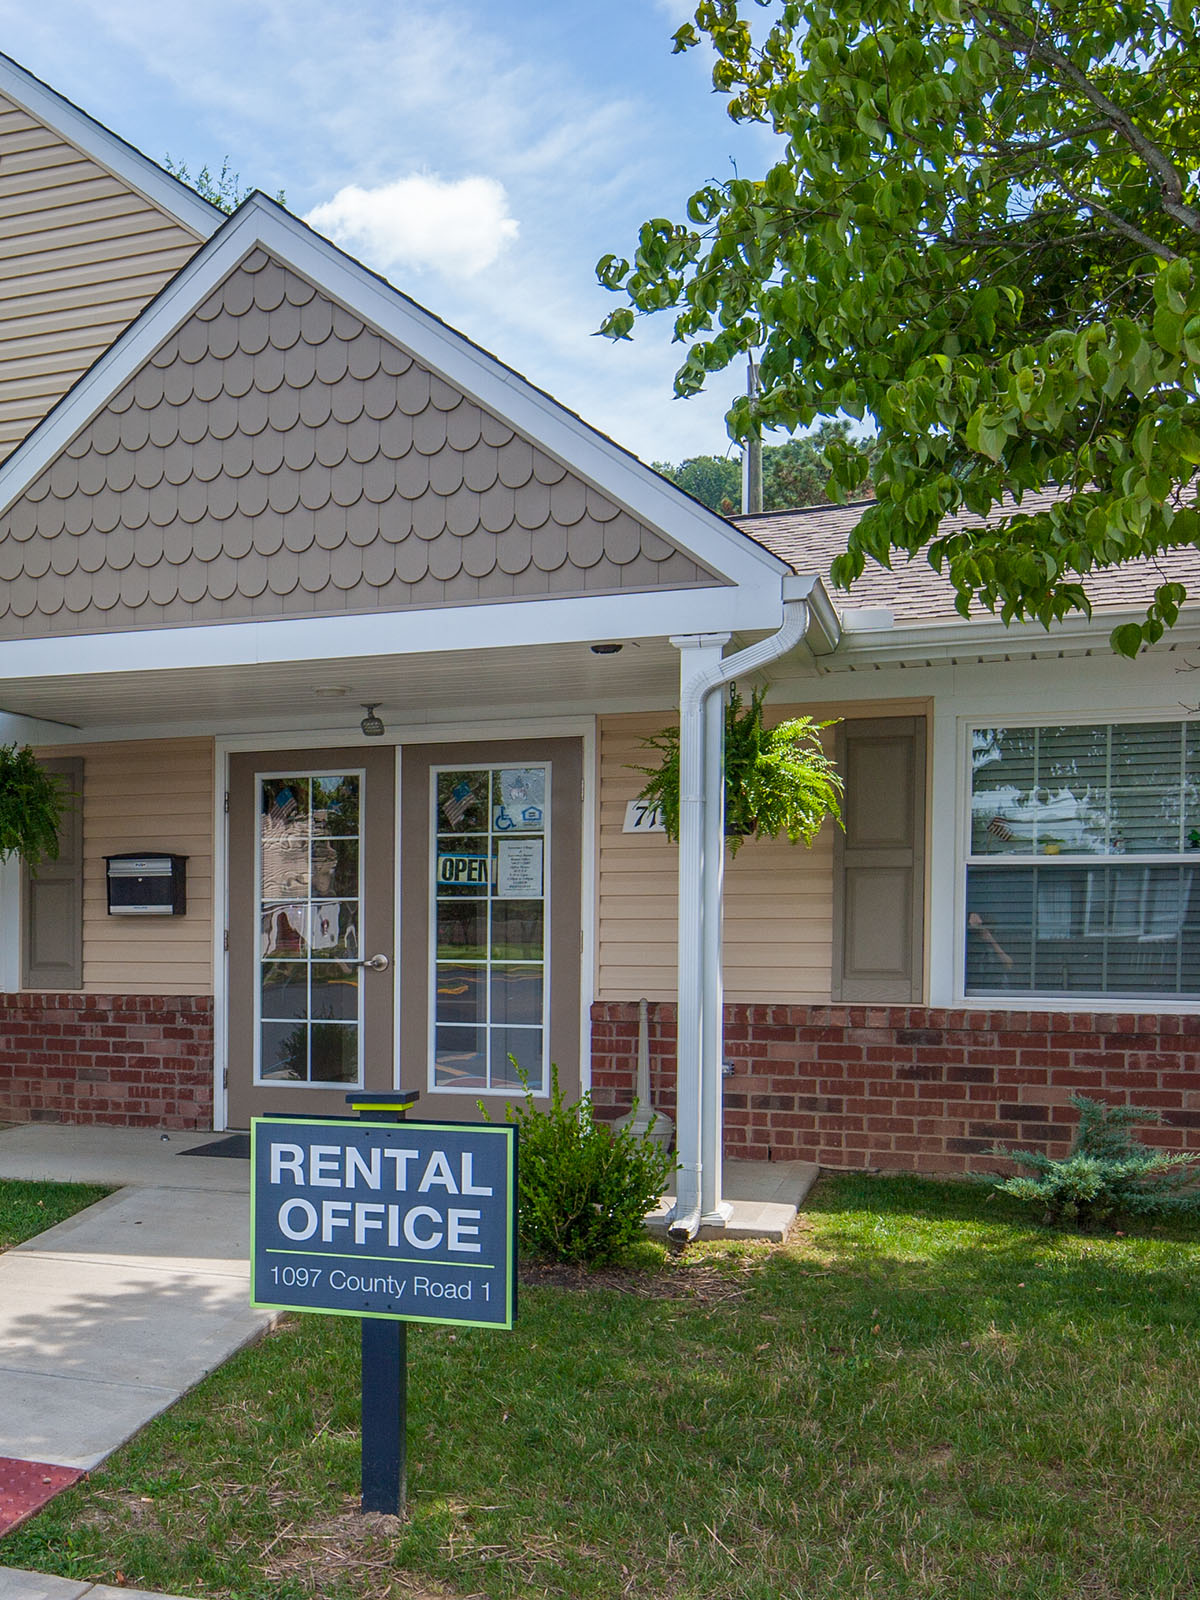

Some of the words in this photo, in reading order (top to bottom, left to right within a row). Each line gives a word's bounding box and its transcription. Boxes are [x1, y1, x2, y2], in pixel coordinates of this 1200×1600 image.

[441, 858, 488, 882] OPEN
[270, 1143, 493, 1197] RENTAL
[278, 1198, 481, 1253] OFFICE
[270, 1266, 322, 1288] 1097
[329, 1270, 407, 1299] County
[413, 1276, 472, 1300] Road
[481, 1282, 491, 1301] 1
